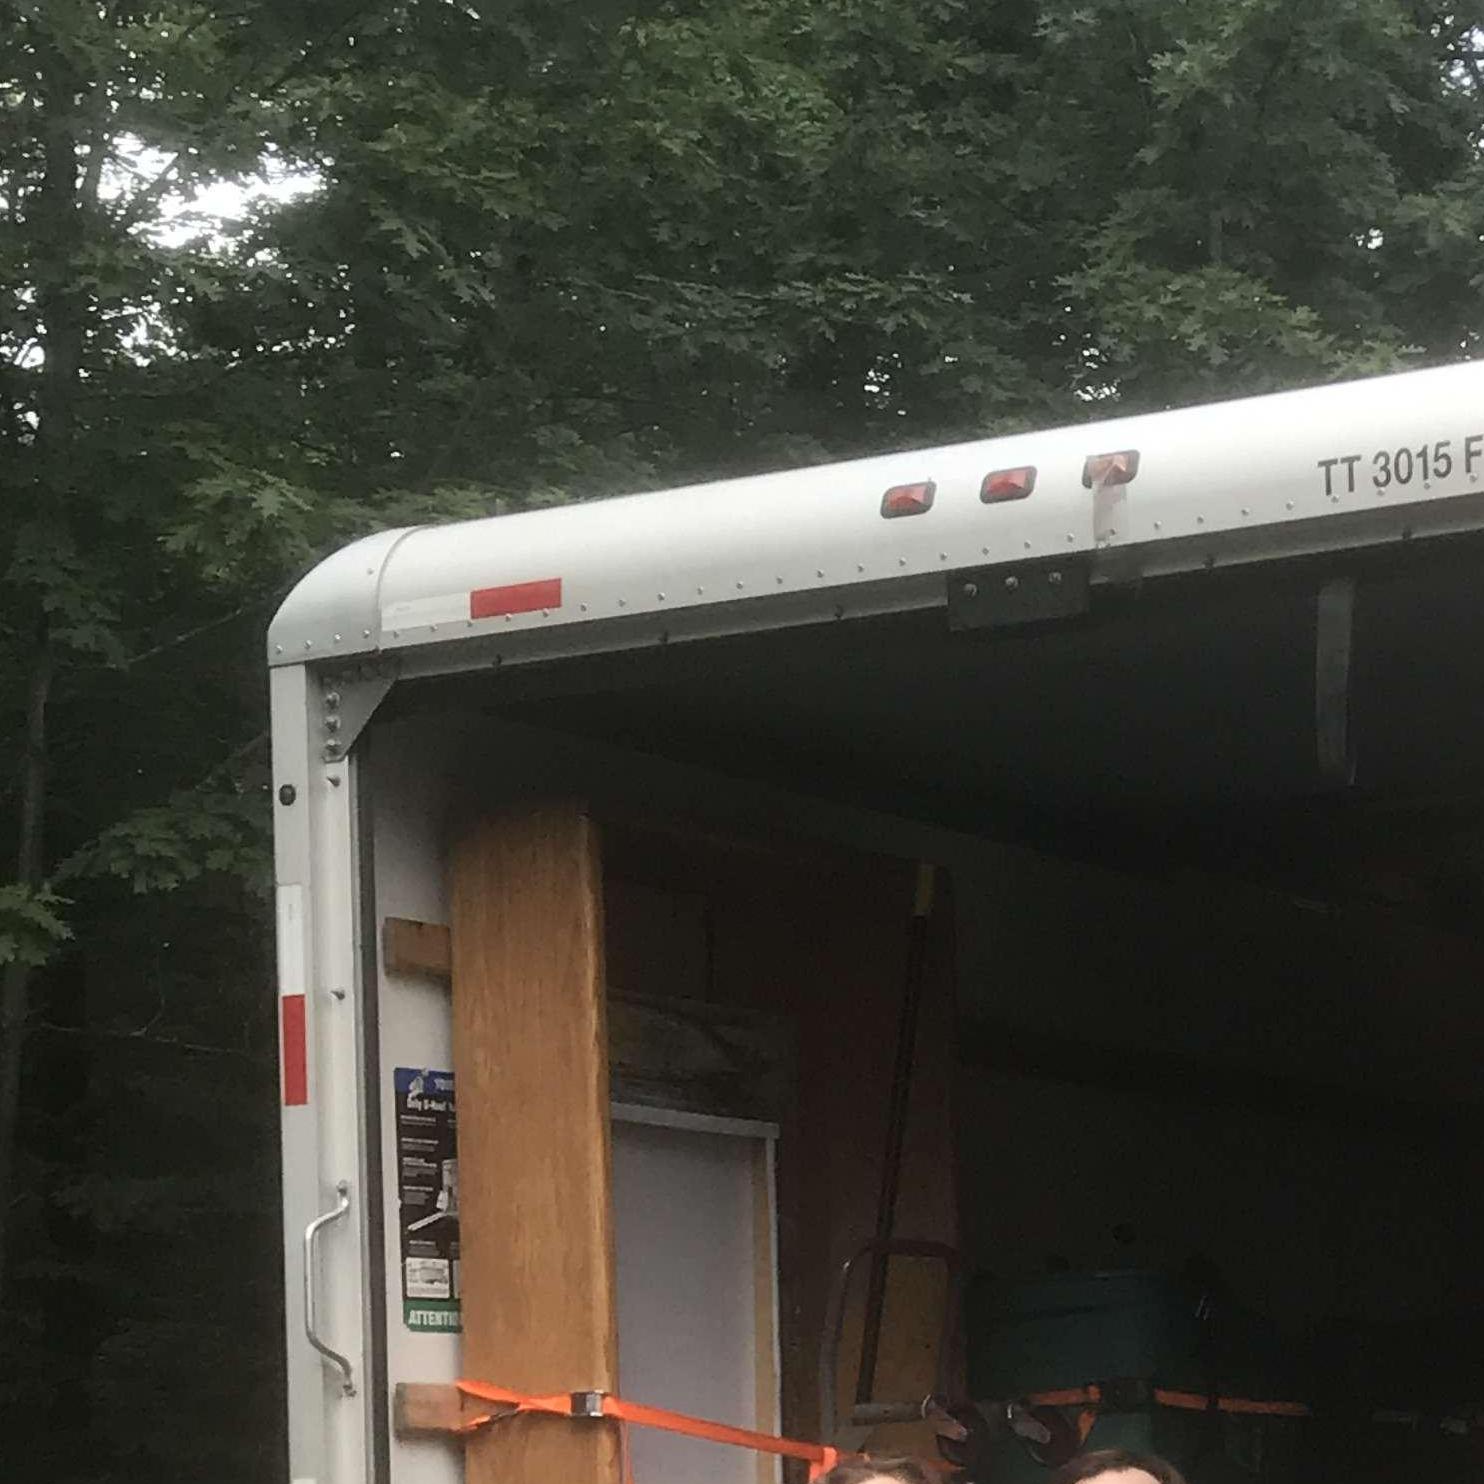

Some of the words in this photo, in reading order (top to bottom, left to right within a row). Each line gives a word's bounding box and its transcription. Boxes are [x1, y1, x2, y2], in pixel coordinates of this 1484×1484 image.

[1317, 455, 1362, 496] TT
[1372, 440, 1452, 488] 3015
[1465, 434, 1484, 473] F
[814, 768, 958, 835] MUSE
